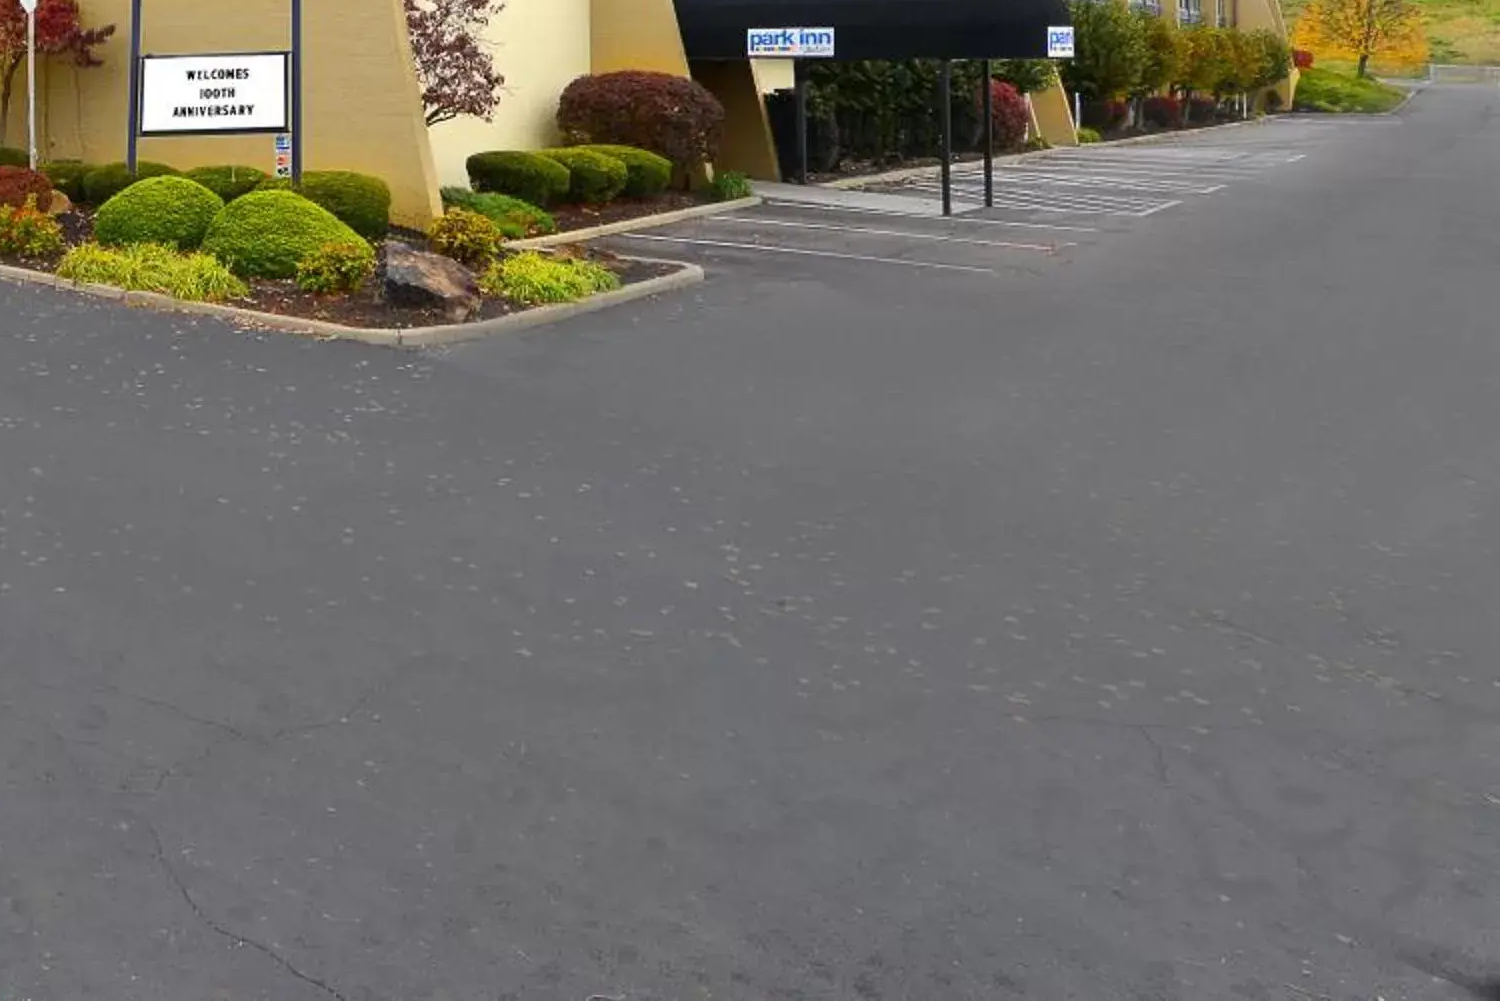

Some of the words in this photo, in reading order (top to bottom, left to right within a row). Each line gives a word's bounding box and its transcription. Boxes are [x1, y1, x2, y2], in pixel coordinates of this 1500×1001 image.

[750, 30, 795, 52] park
[799, 29, 832, 45] inn
[185, 68, 250, 81] WELCOMES
[172, 104, 255, 118] ANNIVERSARY
